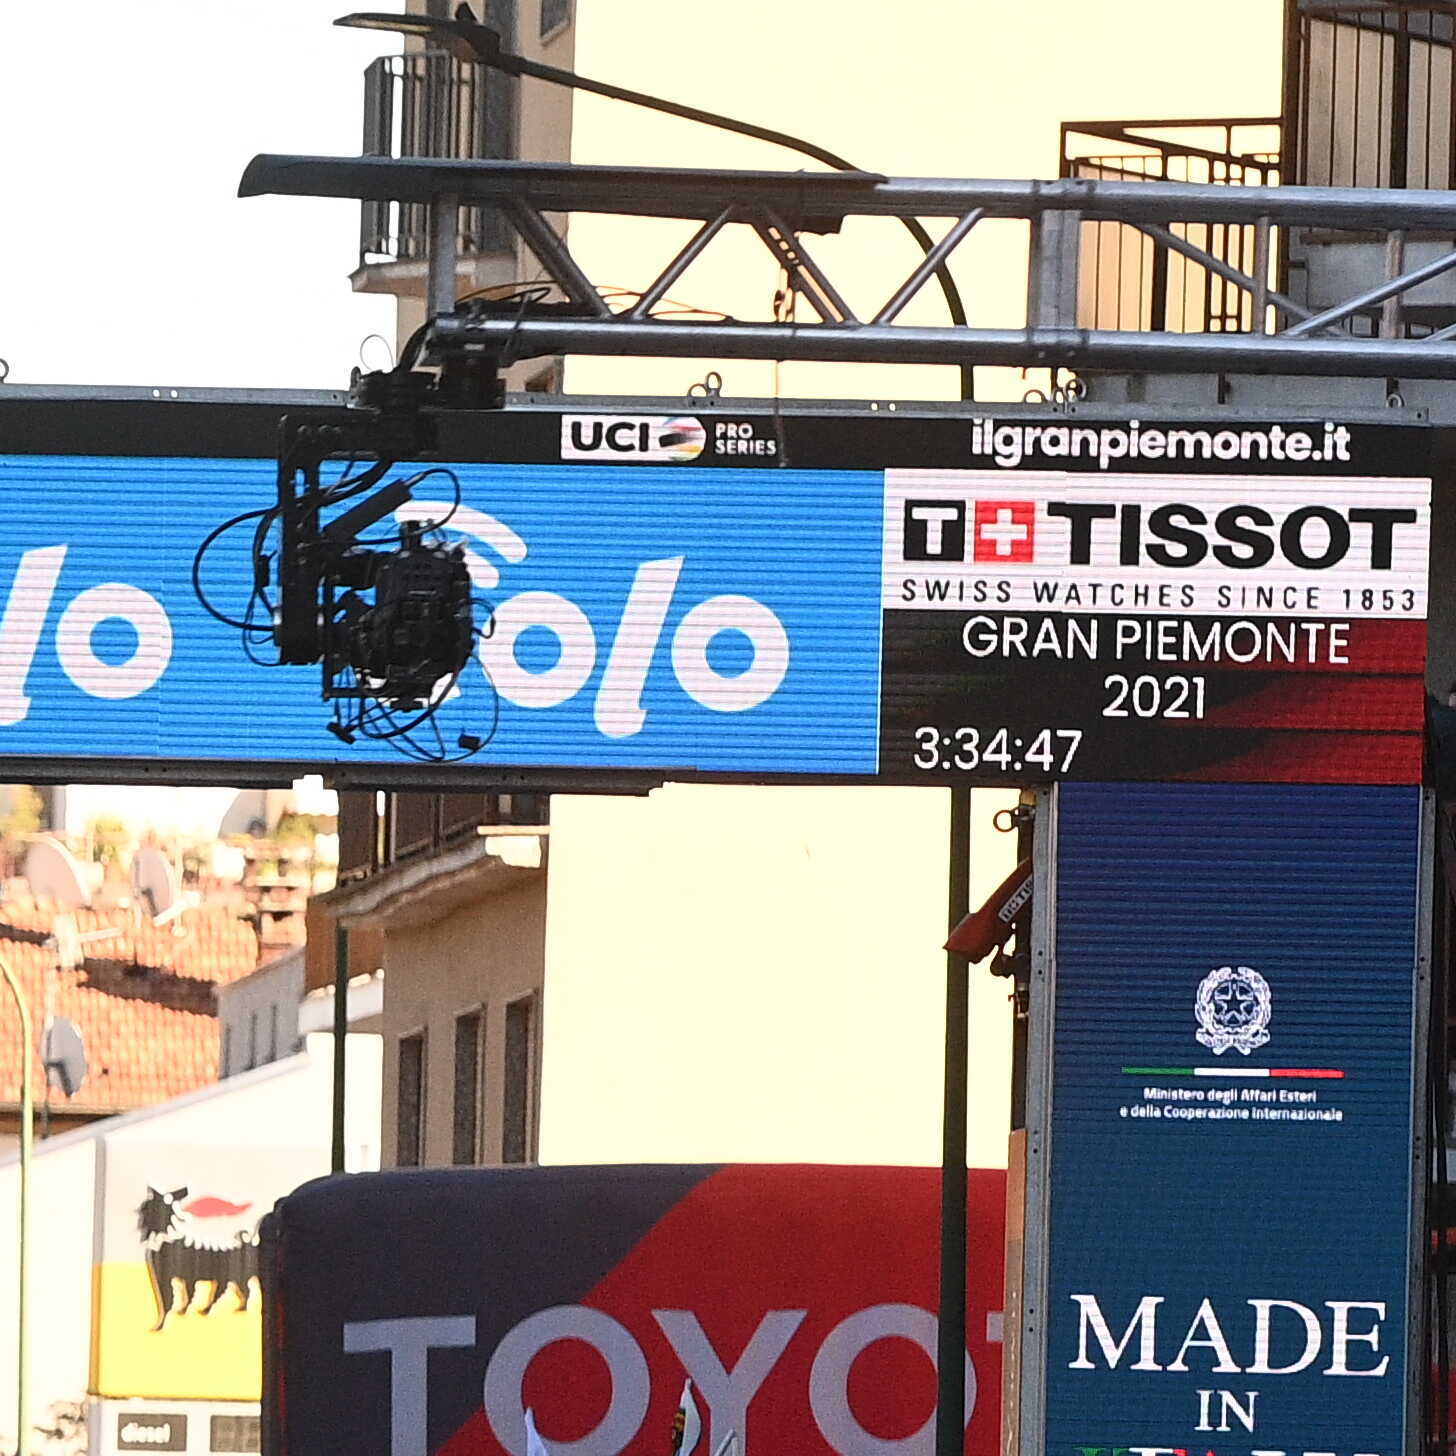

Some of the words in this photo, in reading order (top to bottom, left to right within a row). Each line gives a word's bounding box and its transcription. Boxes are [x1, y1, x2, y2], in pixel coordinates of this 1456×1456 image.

[571, 421, 649, 452] UCI
[714, 438, 777, 456] SERIES
[715, 423, 753, 439] PRO
[972, 419, 1351, 469] ilgranpiemonte.it
[1048, 502, 1417, 570] TISSOT
[902, 579, 1012, 603] SWISS
[1033, 582, 1195, 608] WATCHES
[1218, 585, 1319, 610] SINCE
[1343, 589, 1416, 611] 1853
[398, 556, 789, 738] olo
[962, 616, 1098, 660] GRAN
[1117, 620, 1350, 664] PIEMONTE
[1102, 674, 1206, 719] 2021
[914, 727, 1083, 773] 3:34:47
[1120, 1107, 1128, 1117] e
[1130, 1105, 1161, 1118] della
[1163, 1105, 1249, 1121] Cooperazione
[1252, 1107, 1343, 1121] Internazionale
[1143, 1087, 1205, 1101] Ministero
[1207, 1088, 1237, 1106] degli
[1241, 1089, 1276, 1102] Affari
[1279, 1090, 1317, 1103] Esteri
[1068, 1294, 1390, 1376] MADE
[1194, 1390, 1259, 1433] IN
